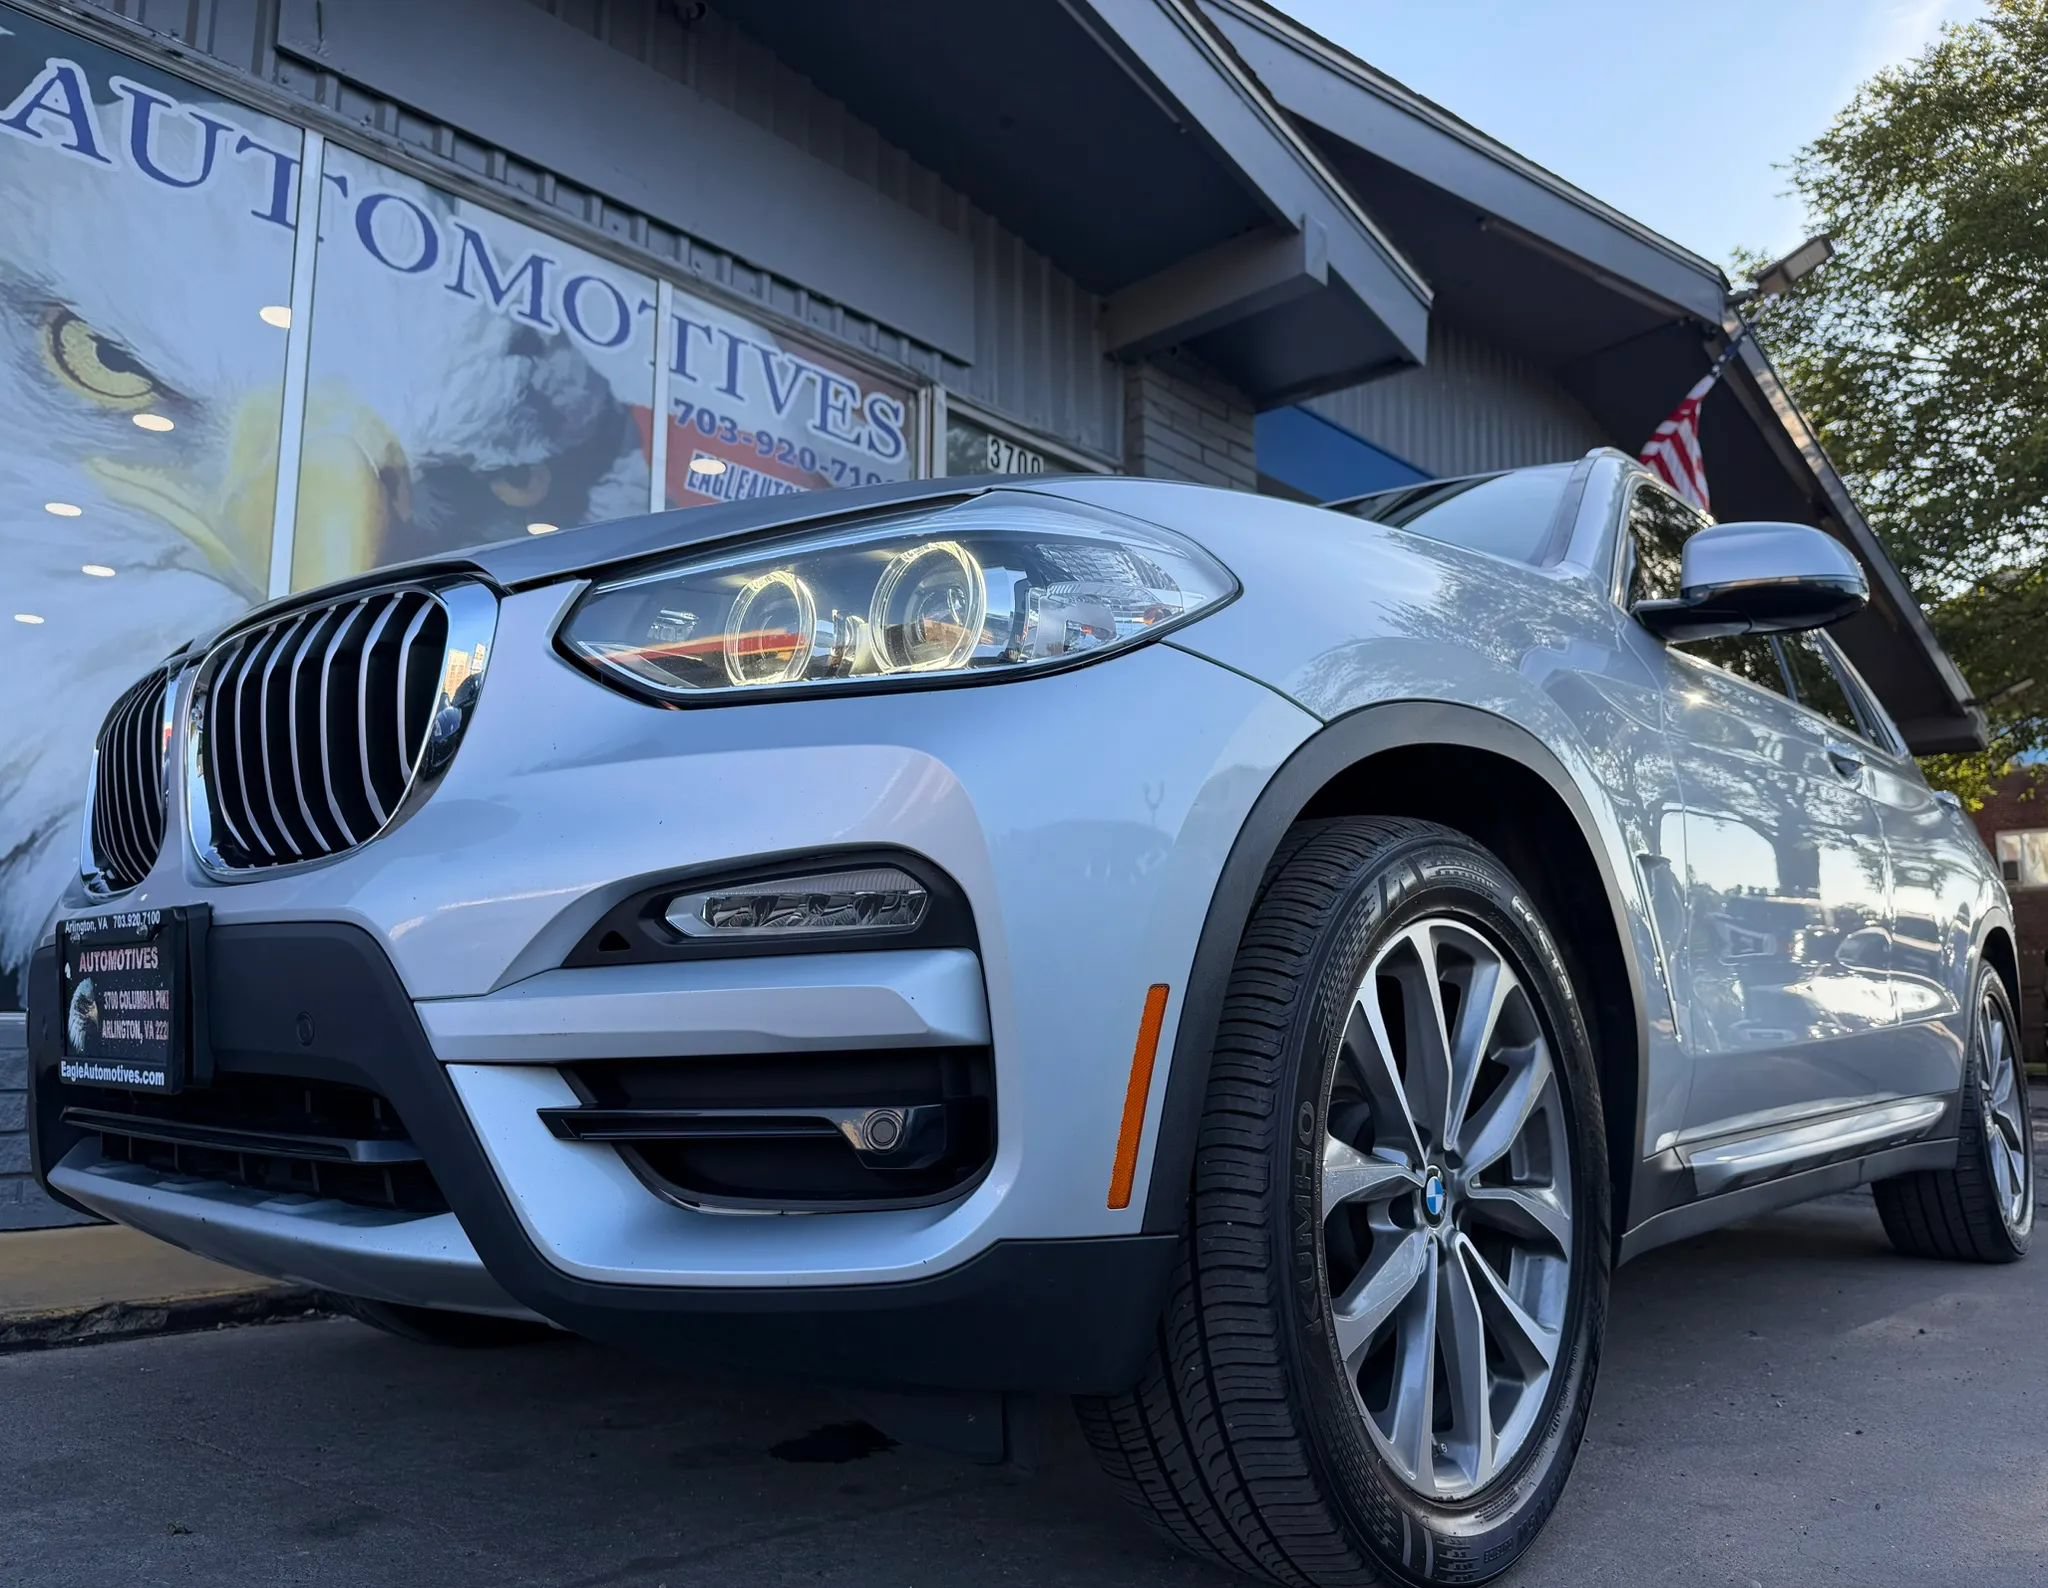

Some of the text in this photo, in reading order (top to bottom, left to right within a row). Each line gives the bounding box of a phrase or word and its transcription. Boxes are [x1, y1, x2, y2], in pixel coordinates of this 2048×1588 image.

[0, 64, 905, 458] AUTOMOTIVES
[674, 397, 894, 487] 703-920-710
[990, 438, 1041, 474] 3700
[65, 910, 161, 935] Arlington, VA 703.920.7100
[79, 946, 159, 973] AUTOMOTIVES
[119, 990, 155, 1010] COLUMBIA
[143, 1020, 155, 1039] VA
[60, 1060, 165, 1086] EagleAutomotives.com
